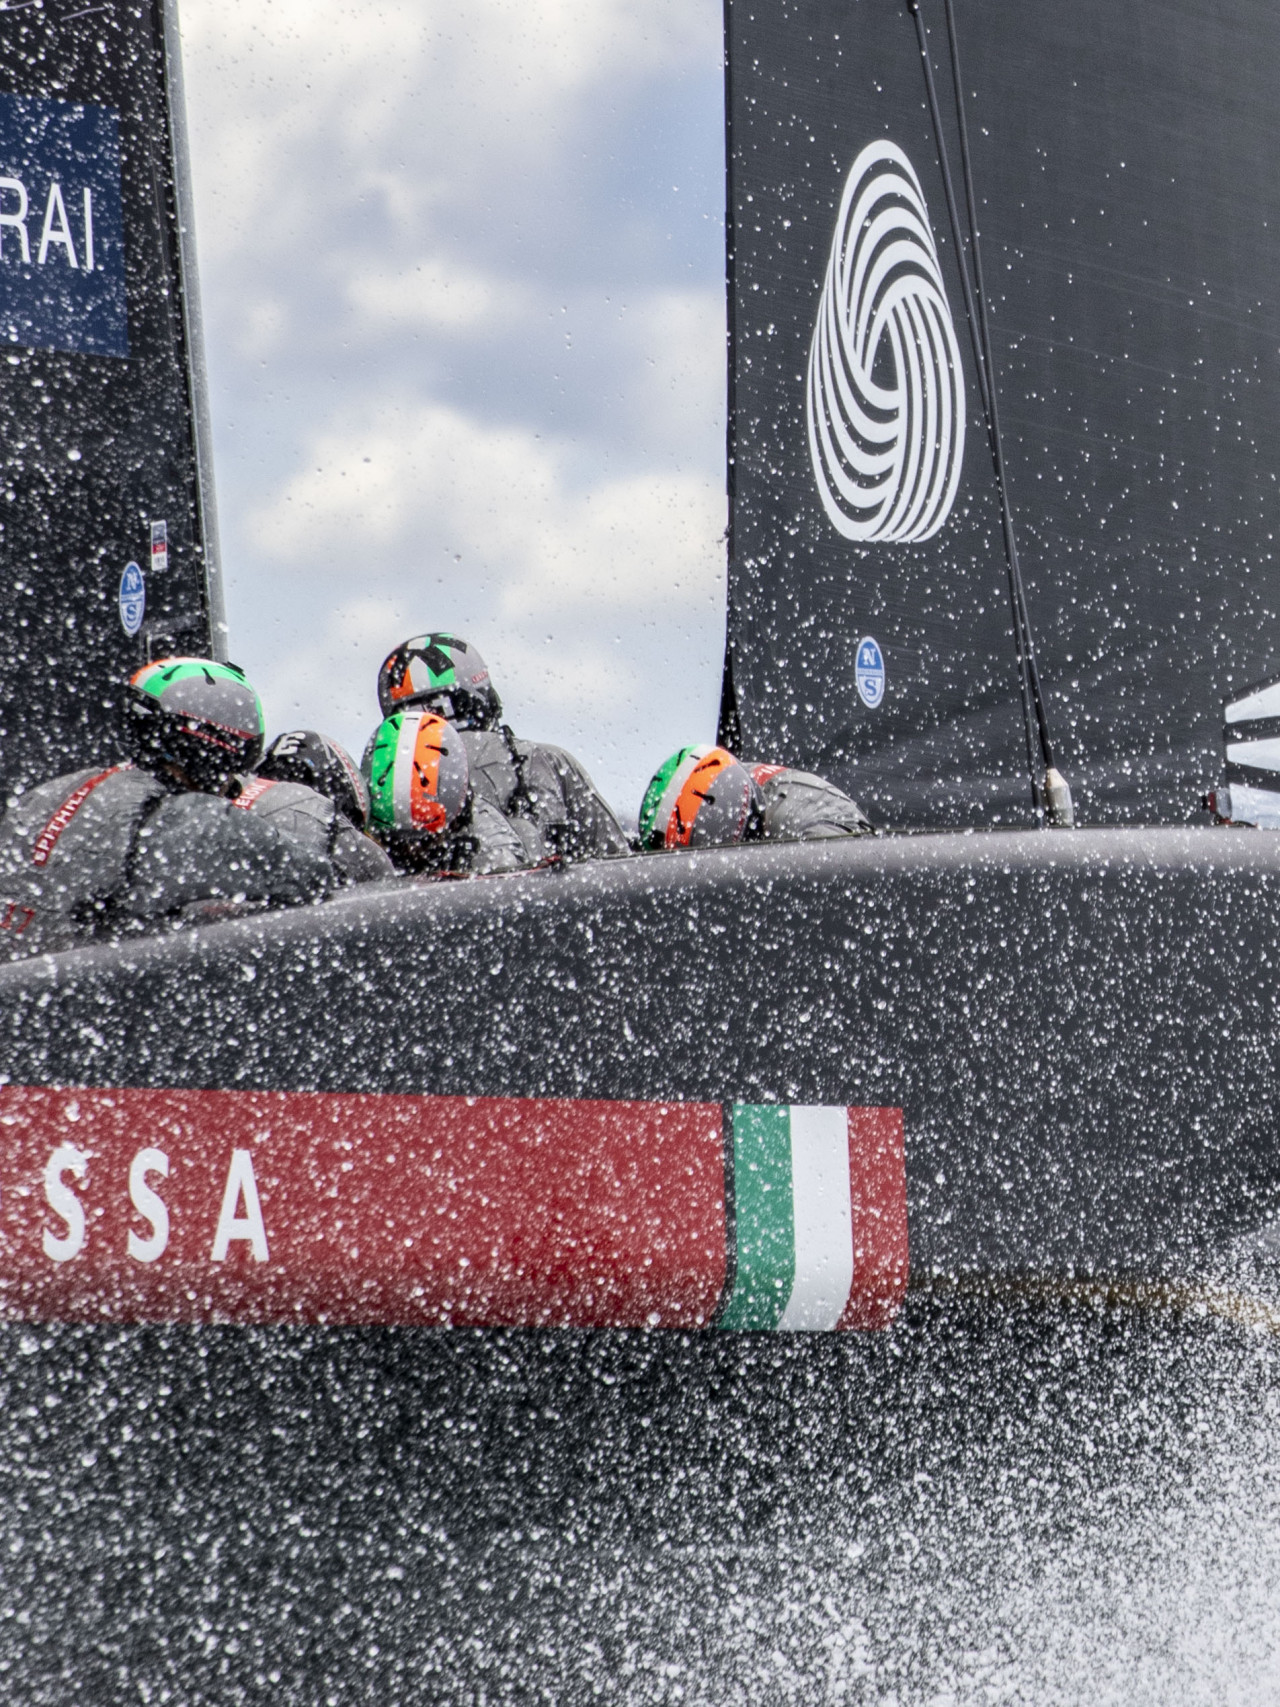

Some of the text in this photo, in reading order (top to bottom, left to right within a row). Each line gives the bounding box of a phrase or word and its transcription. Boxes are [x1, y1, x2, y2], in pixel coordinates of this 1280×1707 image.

[0, 176, 94, 270] RAI
[126, 572, 139, 591] N
[126, 604, 137, 621] S
[862, 647, 876, 666] N
[864, 678, 877, 696] S
[34, 786, 91, 862] SPITHILL
[43, 1147, 270, 1262] SSA
